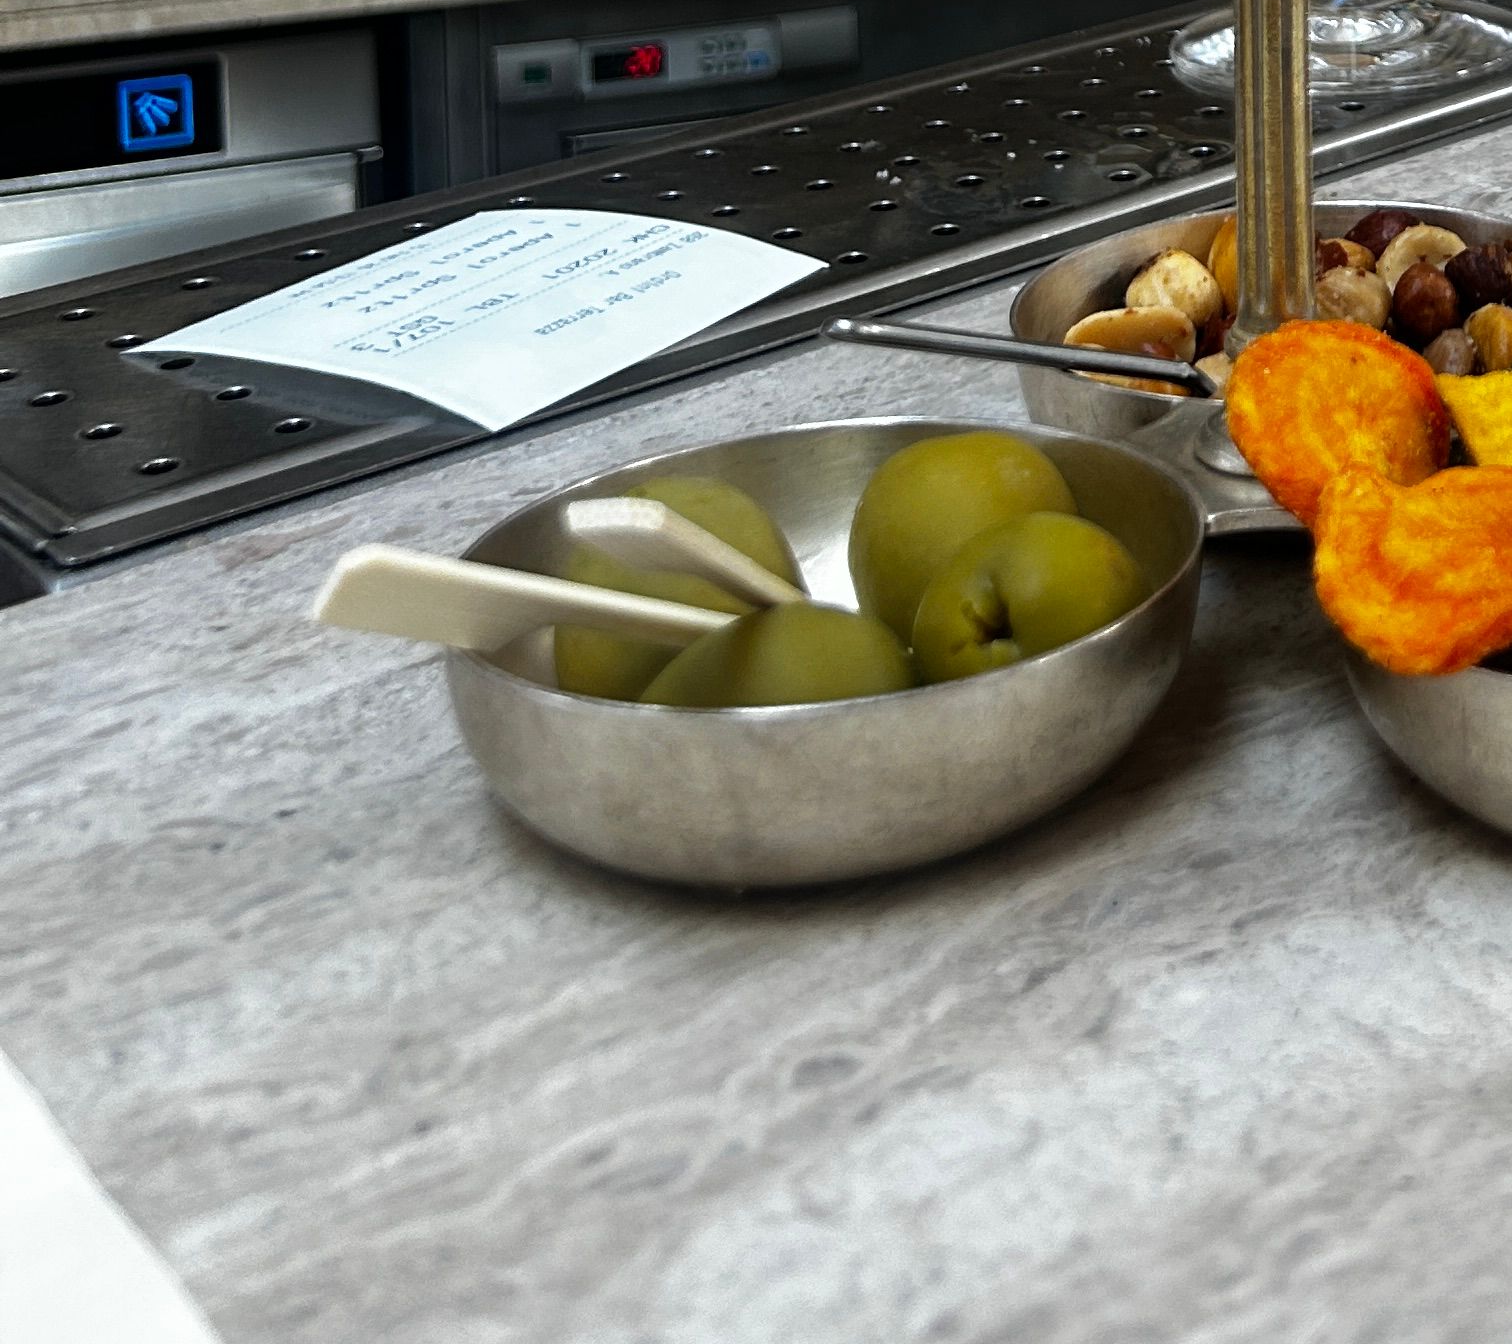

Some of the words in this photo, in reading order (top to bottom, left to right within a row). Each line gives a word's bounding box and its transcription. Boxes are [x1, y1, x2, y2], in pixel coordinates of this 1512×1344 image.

[429, 229, 518, 265] Aperol
[622, 224, 670, 243] CHK
[466, 232, 554, 269] Aperol
[541, 248, 618, 279] 20201
[320, 271, 420, 308] Spritz
[357, 274, 457, 312] Spritz
[464, 293, 519, 312] TBL
[604, 292, 634, 305] Bar
[534, 306, 605, 335] Terrazza
[350, 342, 375, 352] 3
